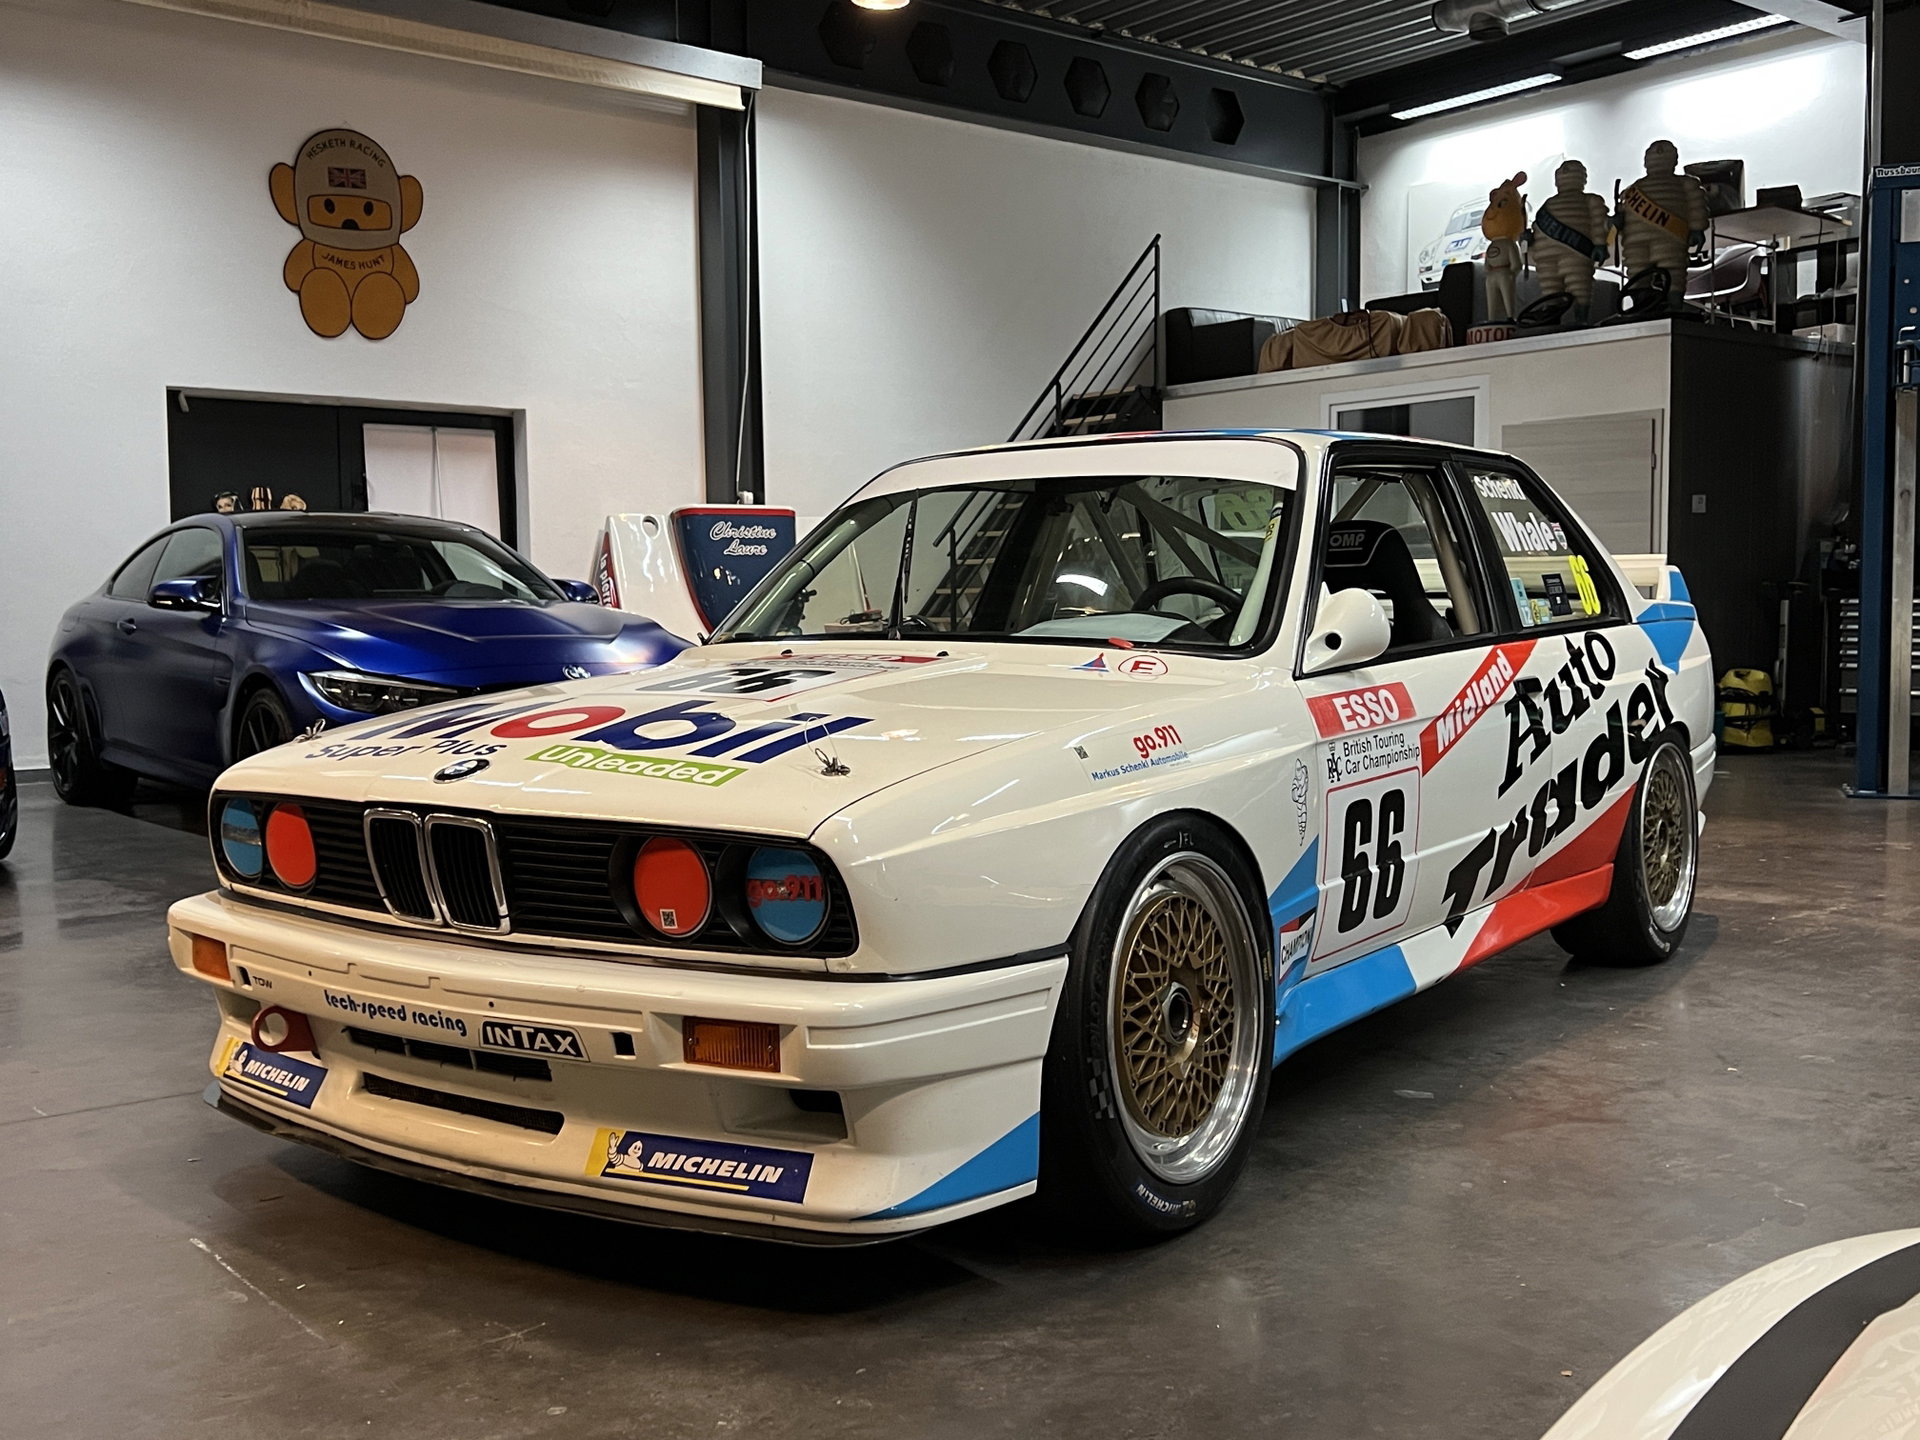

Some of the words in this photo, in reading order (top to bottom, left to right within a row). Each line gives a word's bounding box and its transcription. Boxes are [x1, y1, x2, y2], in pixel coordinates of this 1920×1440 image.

[306, 138, 346, 160] HESKETH
[349, 140, 386, 168] RACING
[321, 252, 356, 270] JAMES
[358, 253, 385, 270] HUNT
[709, 521, 777, 541] Christine
[723, 538, 767, 556] Laure
[1330, 533, 1365, 547] OMP
[1491, 511, 1557, 551] Whale
[1568, 554, 1601, 615] 66
[634, 667, 837, 694] 66
[1129, 660, 1157, 675] E
[1332, 688, 1400, 731] ESSO
[1436, 648, 1514, 755] Midland
[1497, 630, 1617, 800] Auto
[346, 699, 875, 764] Mobil
[1132, 724, 1182, 759] go.911
[1343, 735, 1373, 757] British
[1373, 731, 1405, 749] Touring
[305, 743, 422, 761] Super
[418, 739, 507, 755] Plus
[537, 745, 735, 785] Unleaded
[1091, 767, 1120, 781] Markus
[1150, 750, 1189, 767] Automobile
[1345, 757, 1361, 775] Car
[1362, 743, 1420, 771] Championship
[1441, 657, 1675, 939] Trader
[1337, 788, 1406, 934] 66
[747, 874, 824, 908] go.911
[252, 975, 273, 989] TOW
[323, 989, 407, 1022] tech-speed
[412, 1010, 467, 1037] racing
[485, 1024, 575, 1056] INTAX
[244, 1059, 310, 1092] MICHELIN
[647, 1150, 783, 1184] MICHELIN
